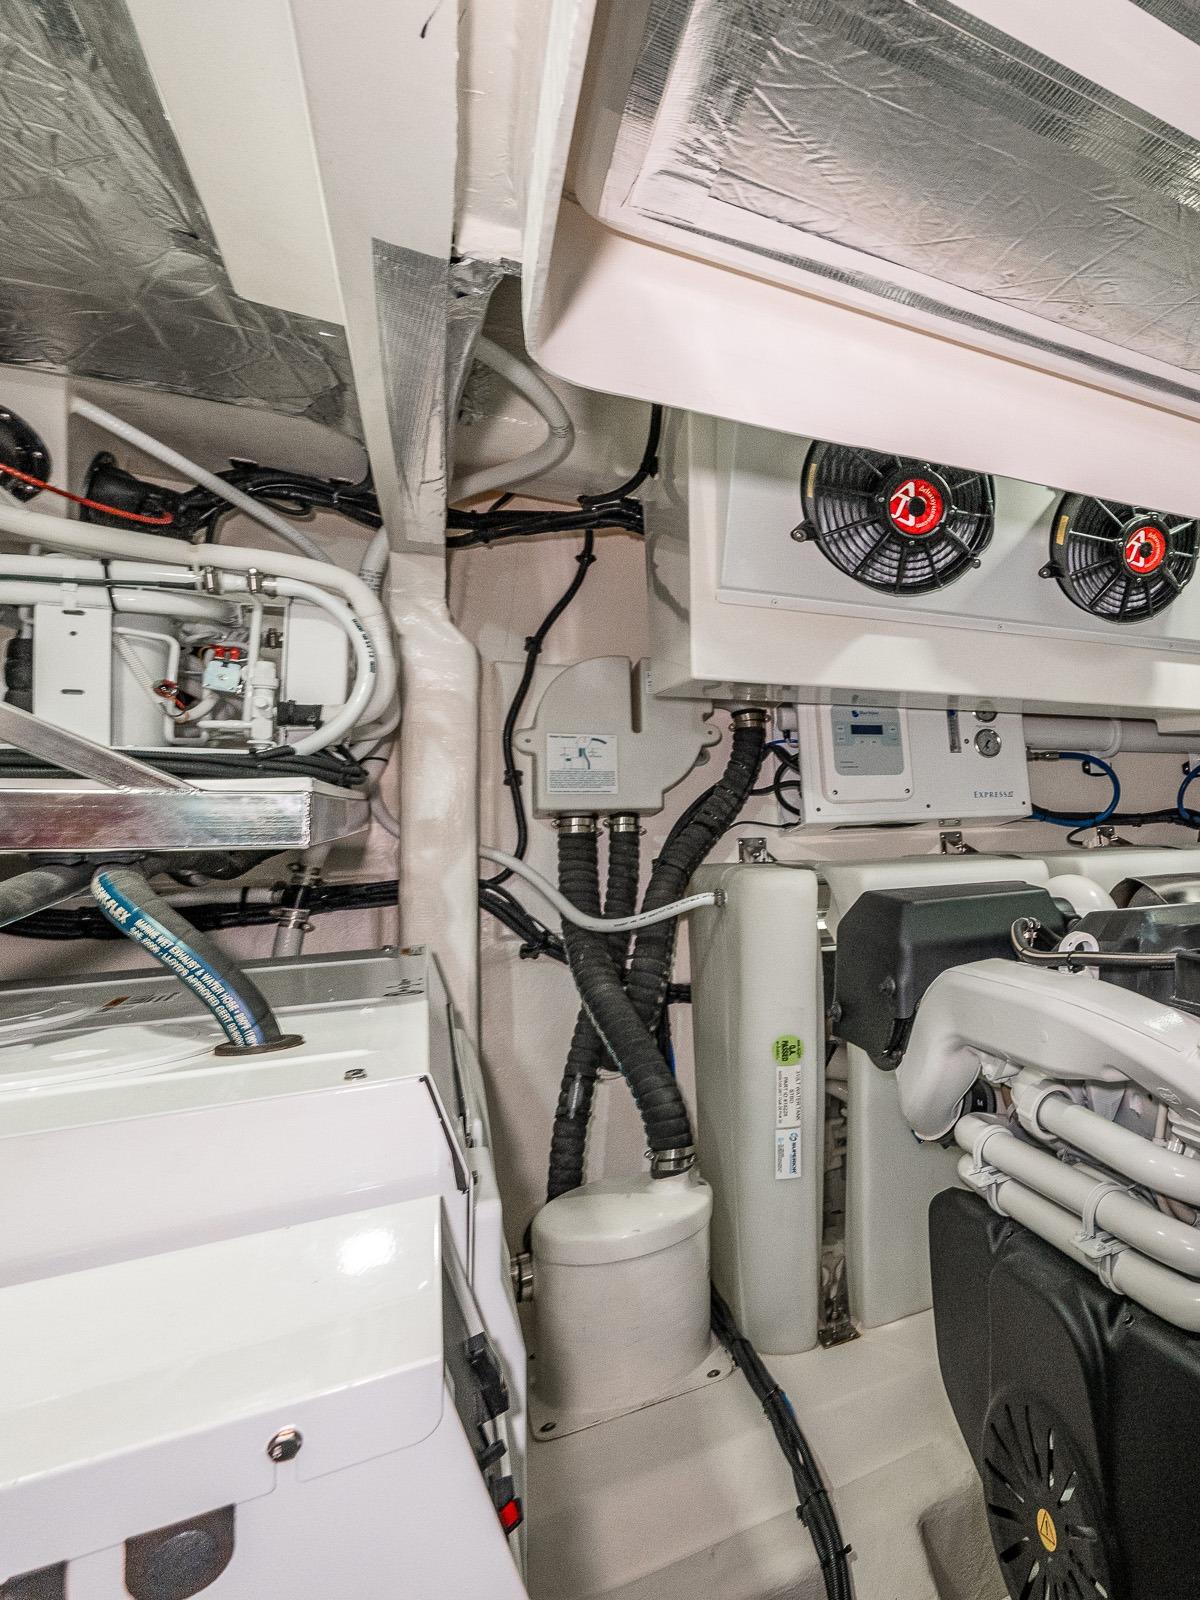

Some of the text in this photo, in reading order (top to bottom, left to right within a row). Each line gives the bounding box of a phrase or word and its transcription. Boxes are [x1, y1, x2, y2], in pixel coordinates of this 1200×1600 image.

[155, 934, 175, 950] WET
[169, 945, 202, 971] EXHAUST
[200, 972, 226, 995] WATER
[220, 992, 240, 1012] HOSE
[185, 974, 220, 1007] APPROVED
[215, 1005, 234, 1024] CERT
[781, 1040, 790, 1062] PASSED
